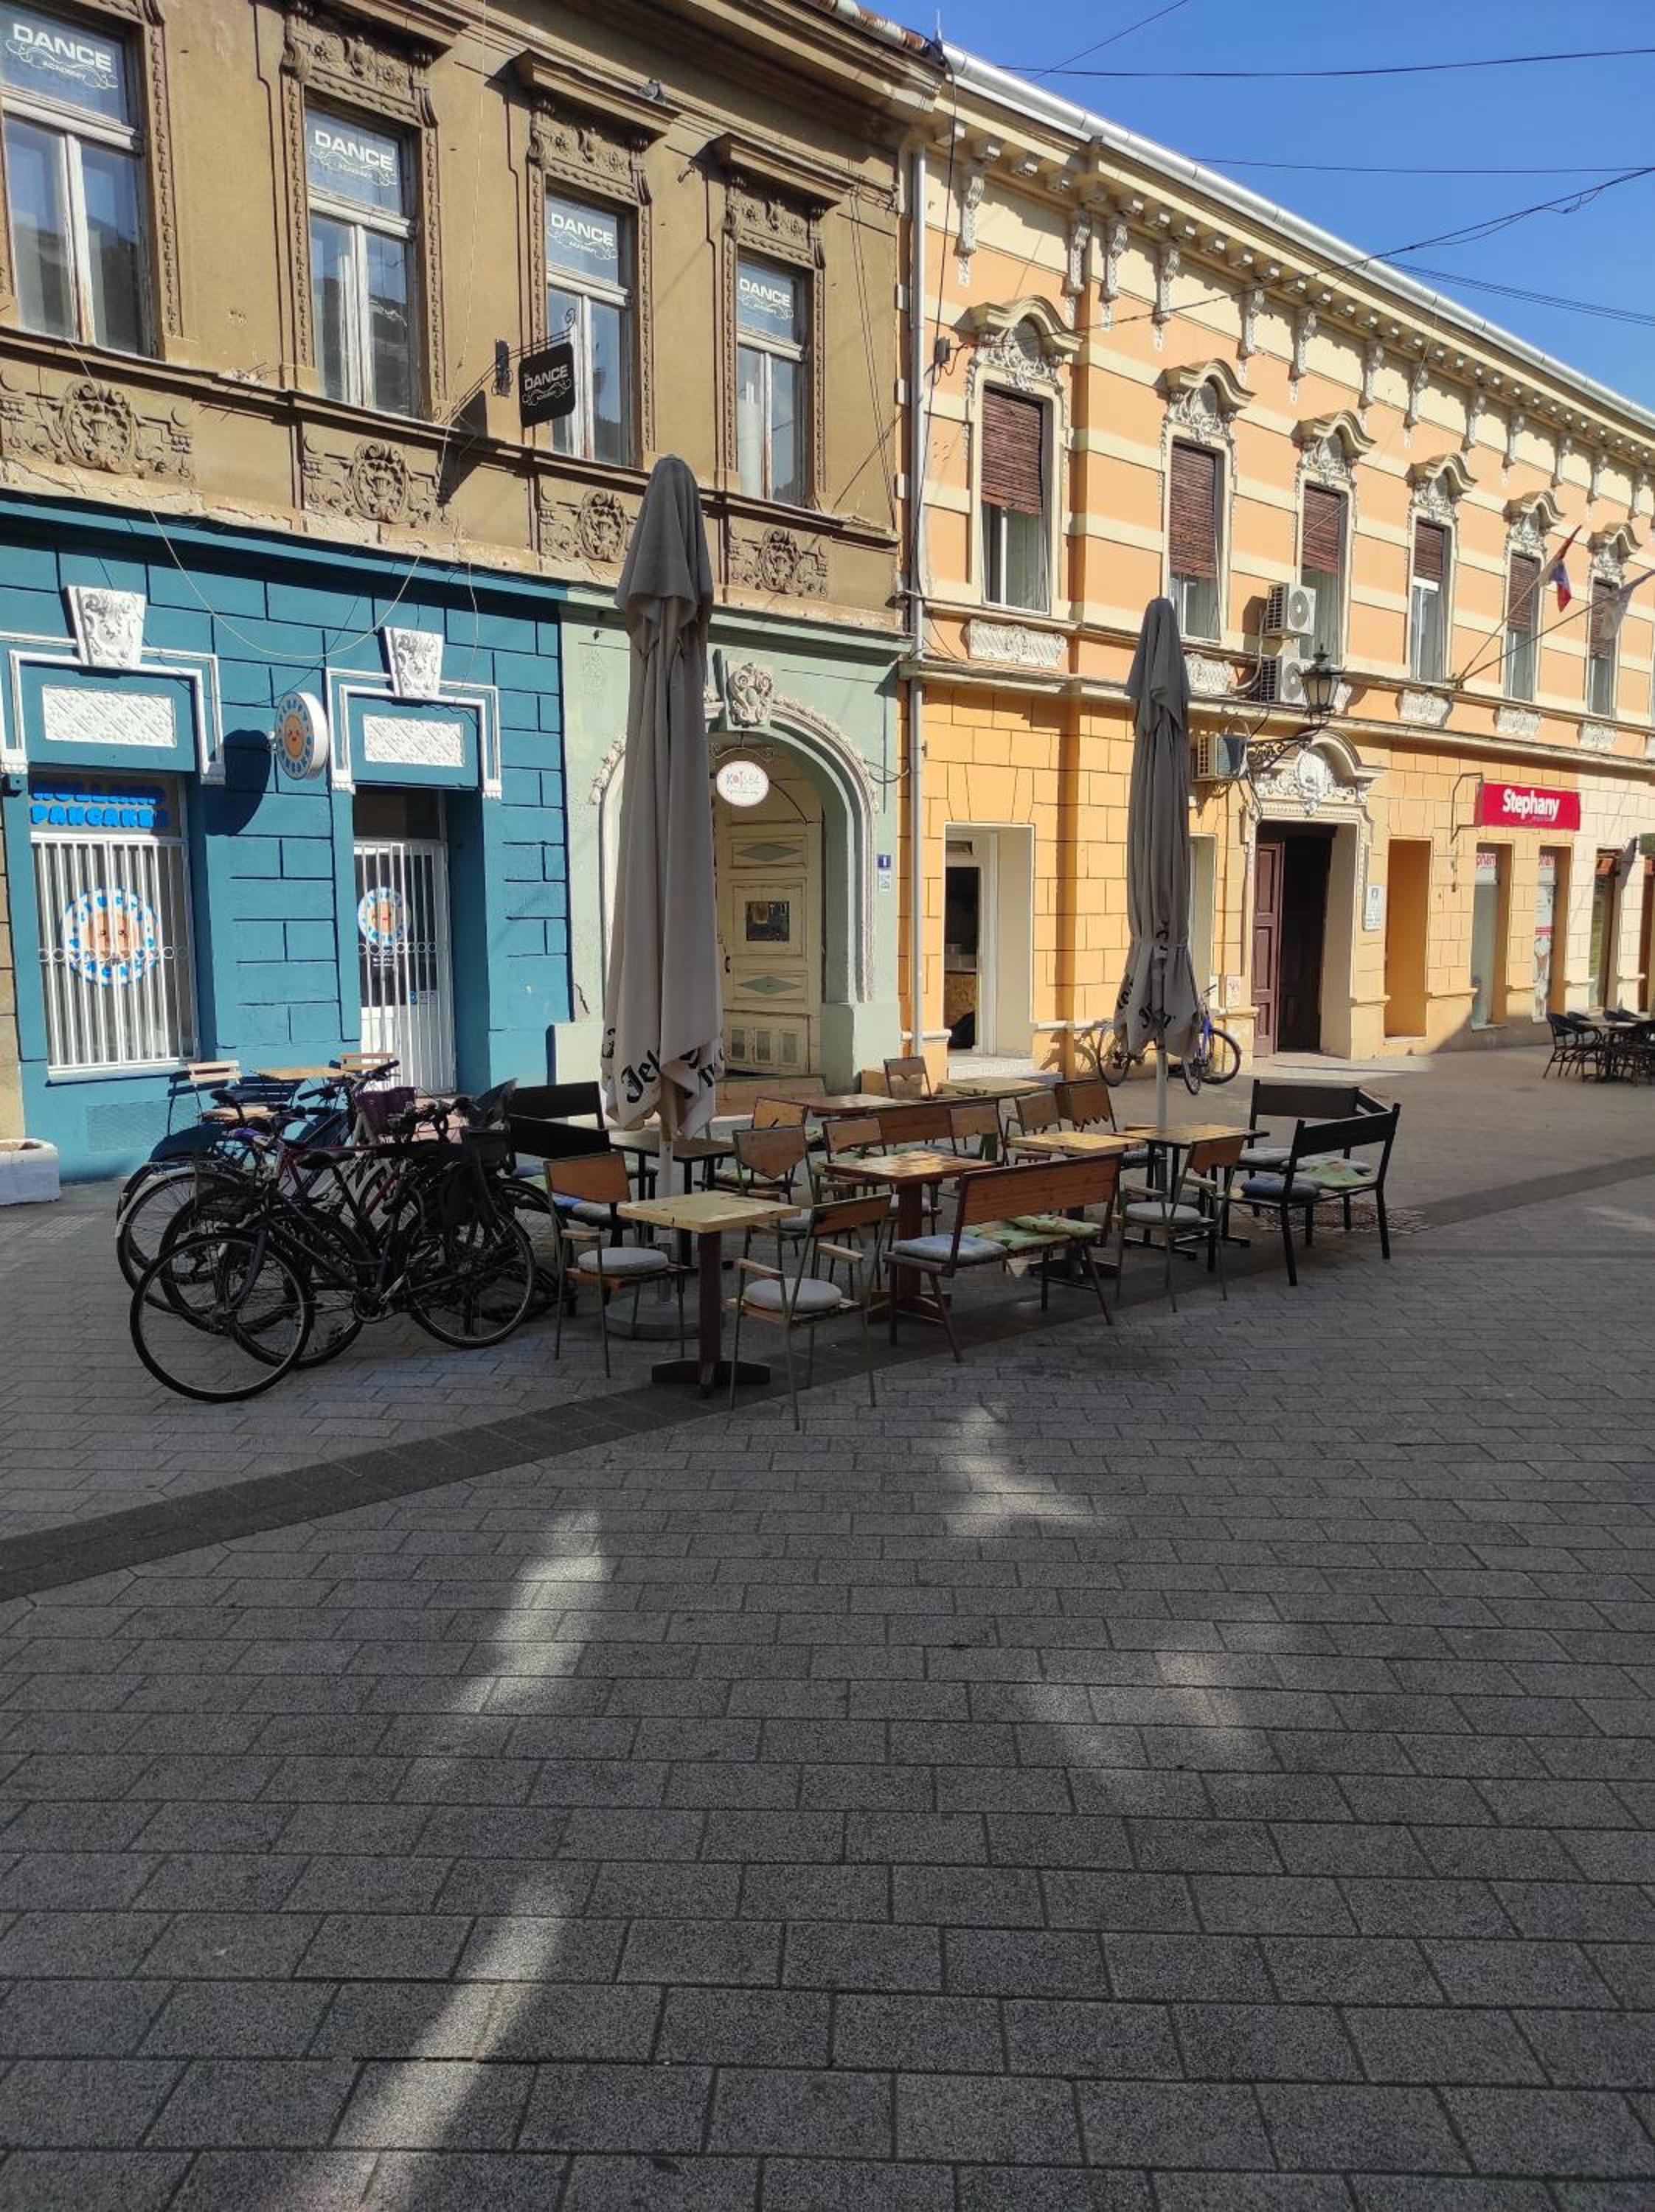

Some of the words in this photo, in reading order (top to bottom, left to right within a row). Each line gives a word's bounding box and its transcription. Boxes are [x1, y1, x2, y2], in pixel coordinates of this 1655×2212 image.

[13, 23, 112, 73] DANCE
[315, 129, 395, 171] DANCE
[551, 212, 614, 246] DANCE
[740, 277, 791, 307] DANCE
[524, 364, 569, 392] DANCE
[1502, 788, 1561, 821] Stephany
